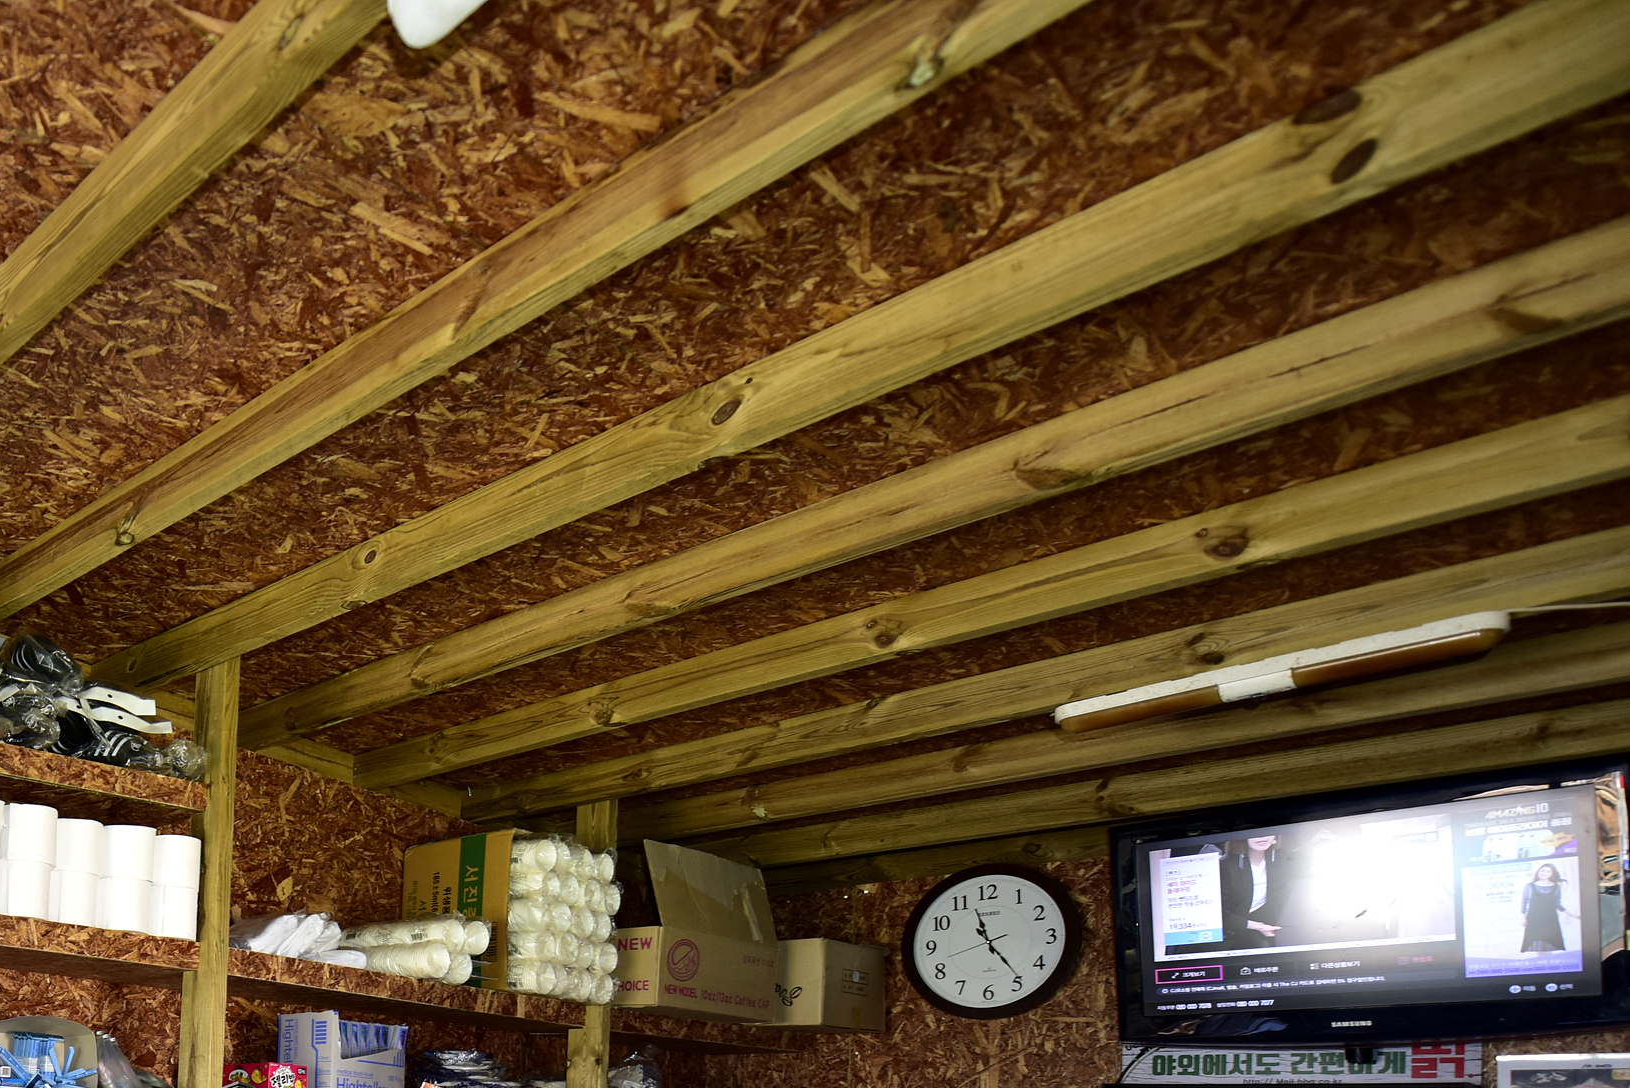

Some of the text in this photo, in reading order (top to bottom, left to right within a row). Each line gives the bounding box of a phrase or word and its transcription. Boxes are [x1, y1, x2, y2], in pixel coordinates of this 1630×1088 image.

[978, 884, 998, 901] 12
[1015, 889, 1023, 905] 1
[952, 895, 969, 911] 11
[1033, 905, 1046, 921] 2
[933, 915, 950, 931] 10
[617, 936, 653, 951] NEW
[1045, 928, 1057, 945] 3
[926, 940, 937, 955] 9
[1033, 955, 1046, 970] 4
[1320, 961, 1361, 969] 다른상품보기
[935, 963, 946, 980] 8
[955, 980, 966, 995] 7
[1011, 975, 1023, 992] 5
[664, 983, 678, 995] NEW
[679, 985, 698, 999] MODEL
[735, 995, 757, 1007] Coffee
[983, 984, 994, 1000] 6
[1331, 1020, 1373, 1028] SAMSUNG
[1152, 1053, 1284, 1077] 야외에서도
